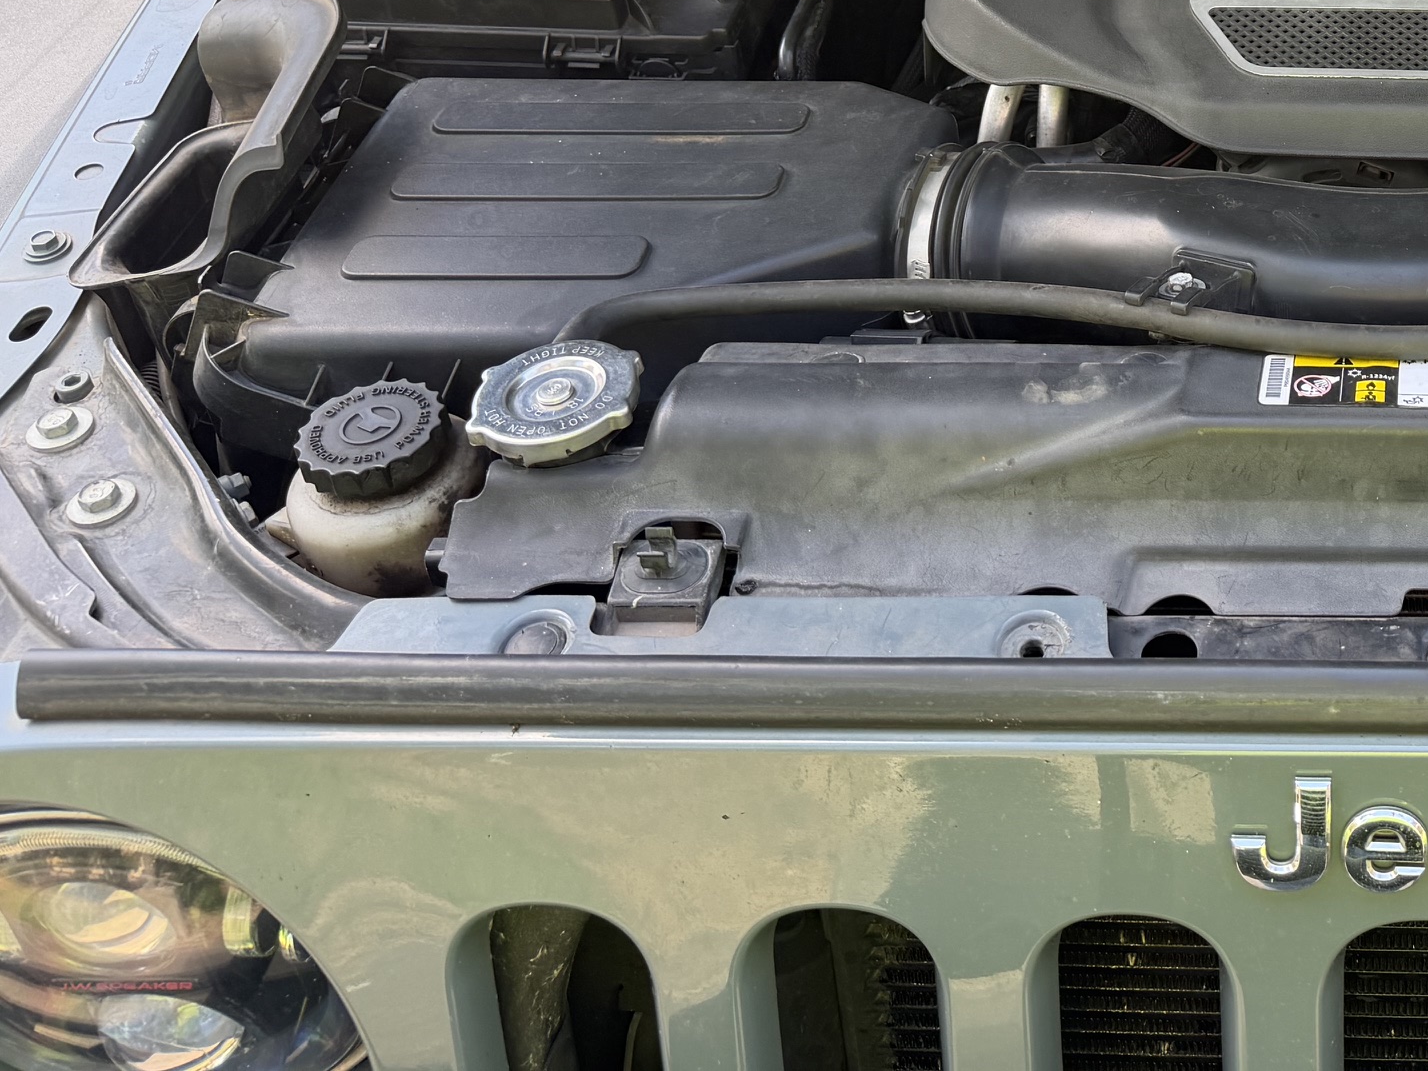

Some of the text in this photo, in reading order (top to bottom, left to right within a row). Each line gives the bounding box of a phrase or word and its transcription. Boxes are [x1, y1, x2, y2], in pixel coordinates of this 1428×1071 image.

[522, 346, 605, 367] KEEP TIGHT
[595, 391, 614, 410] DO
[324, 385, 432, 451] POWER STEERING FLUID
[484, 409, 506, 427] HOT
[559, 414, 590, 431] NOT
[506, 424, 546, 438] OPEN
[309, 425, 386, 465] USE APPROVED
